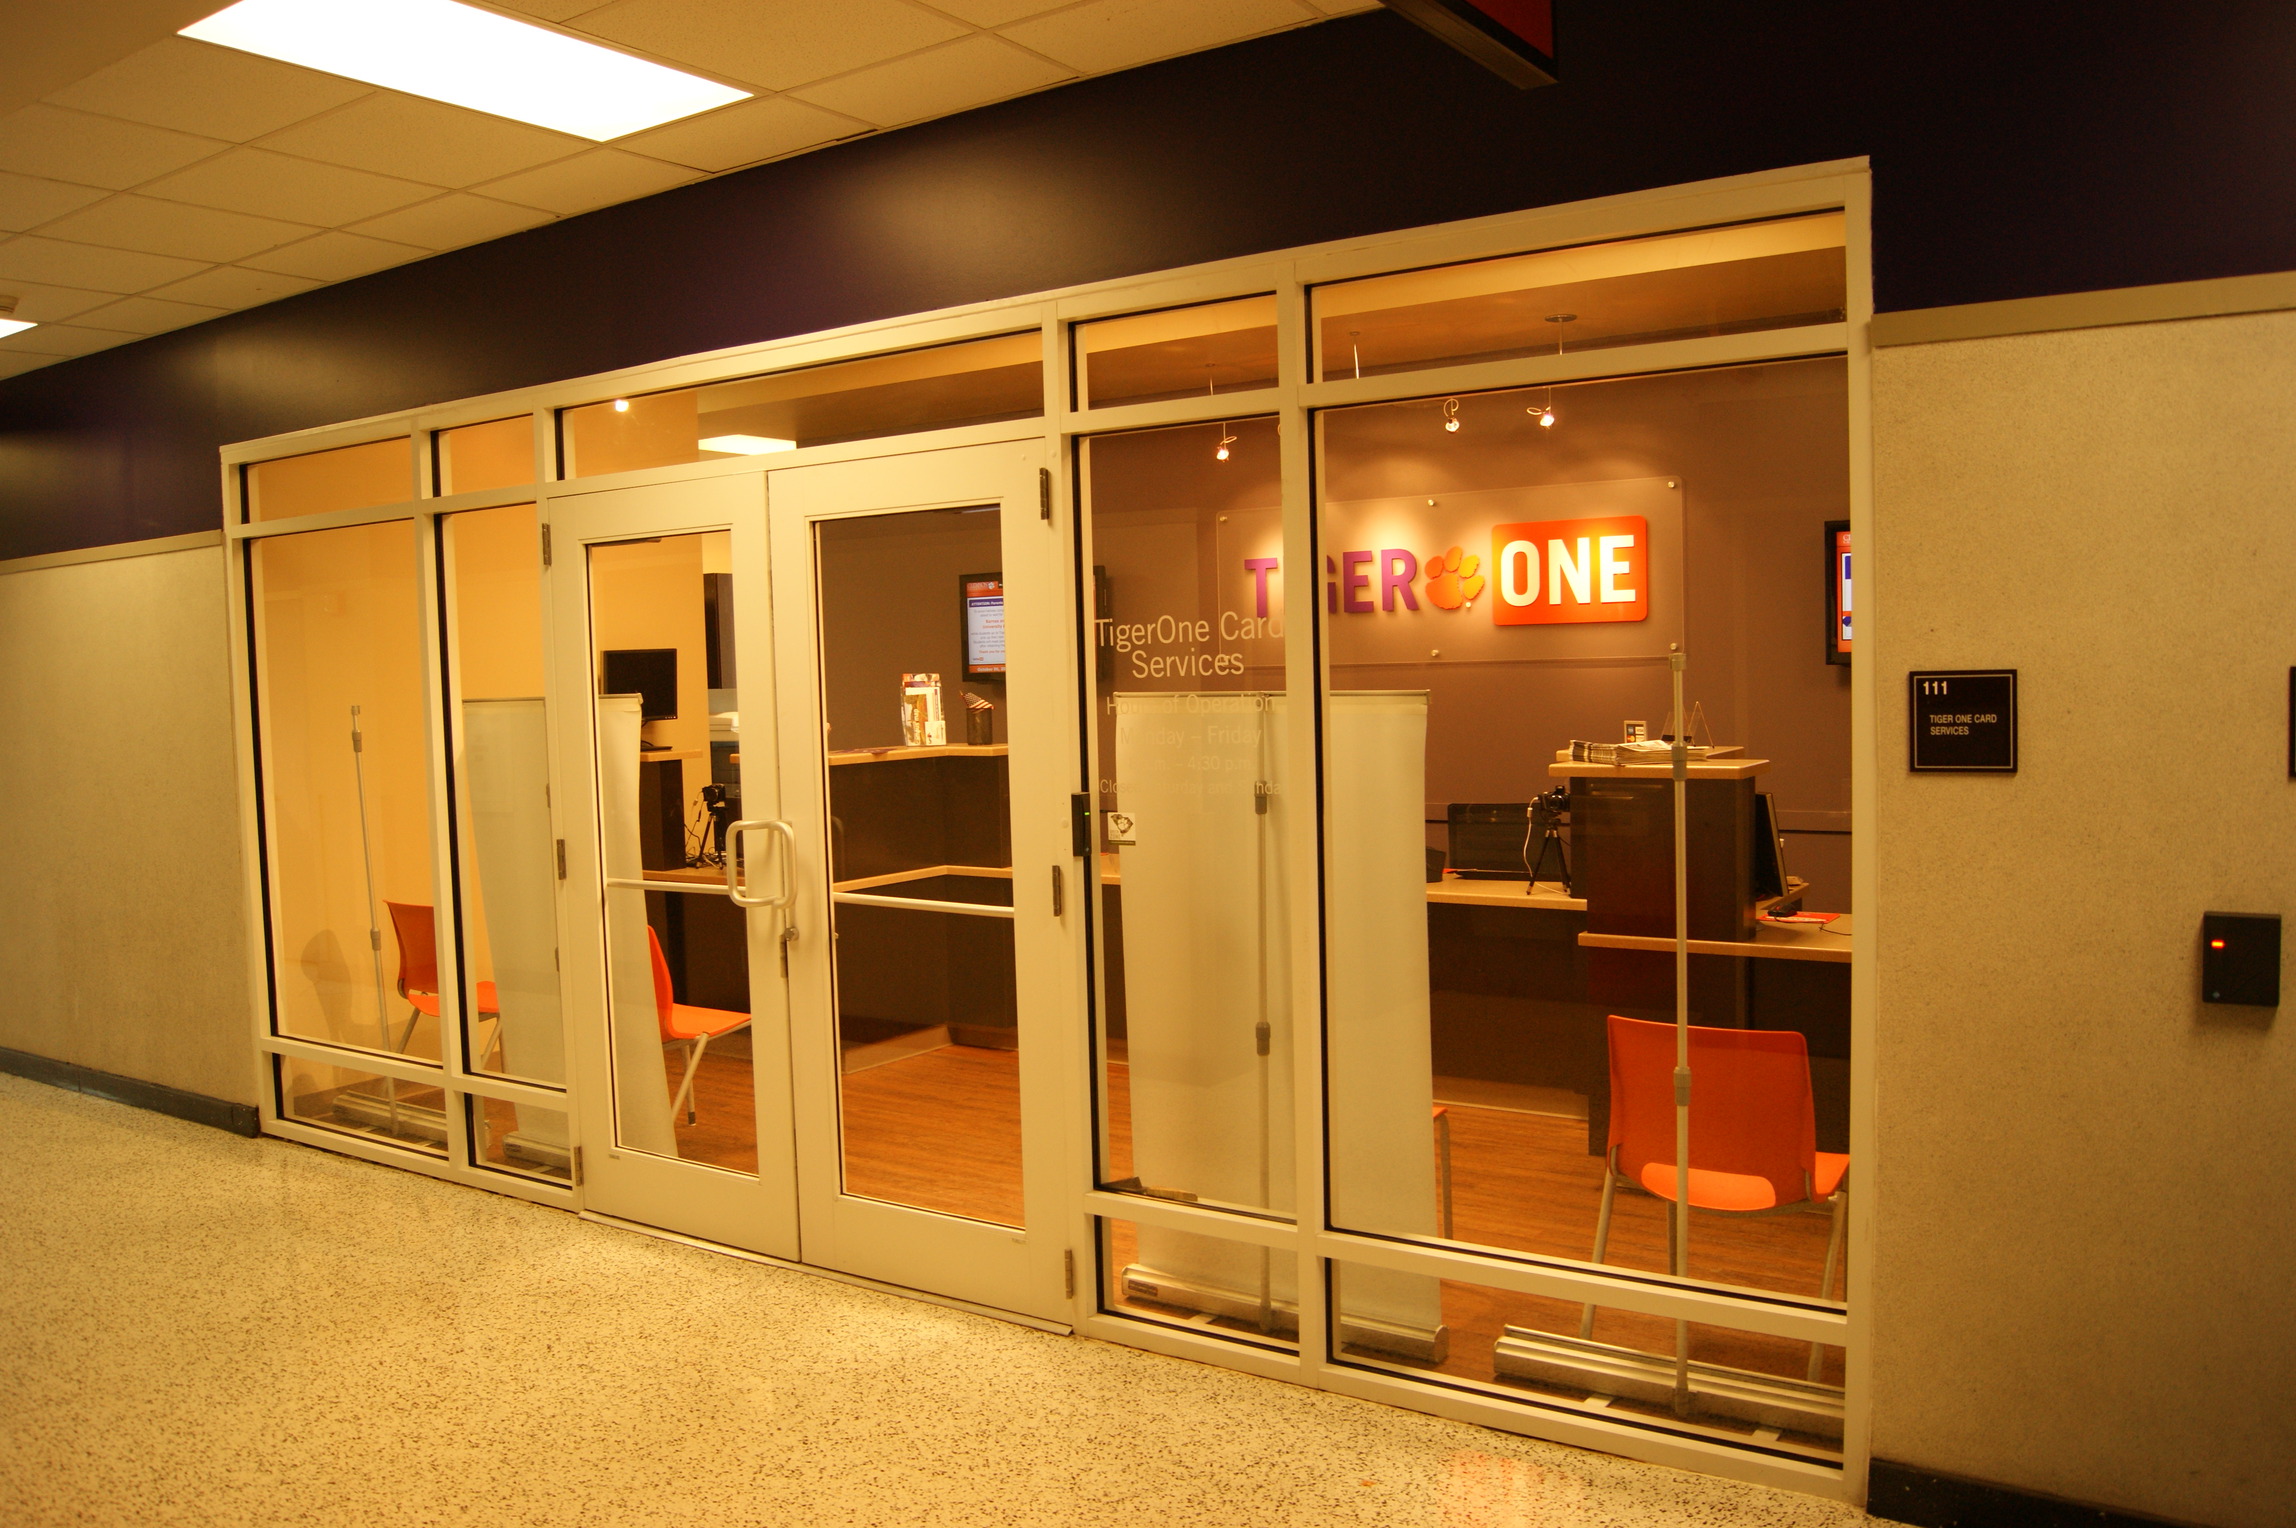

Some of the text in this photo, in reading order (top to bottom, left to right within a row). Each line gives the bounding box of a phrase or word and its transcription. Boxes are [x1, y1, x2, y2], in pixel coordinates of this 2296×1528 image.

[1500, 534, 1637, 607] ONE
[1244, 548, 1420, 618] TER
[1094, 609, 1285, 652] TigerOne Card
[1131, 647, 1245, 679] Services
[1923, 680, 1948, 696] 111
[1106, 692, 1276, 717] Hou of Operation
[1929, 714, 1997, 724] TIGER ONE CARD
[1930, 726, 1969, 735] SERVICES
[1120, 727, 1186, 749] Mnday
[1207, 725, 1262, 749] Friday
[1187, 755, 1222, 771] 4:30
[1099, 778, 1142, 794] Close
[1147, 779, 1204, 797] aturday
[1238, 779, 1283, 795] Snda
